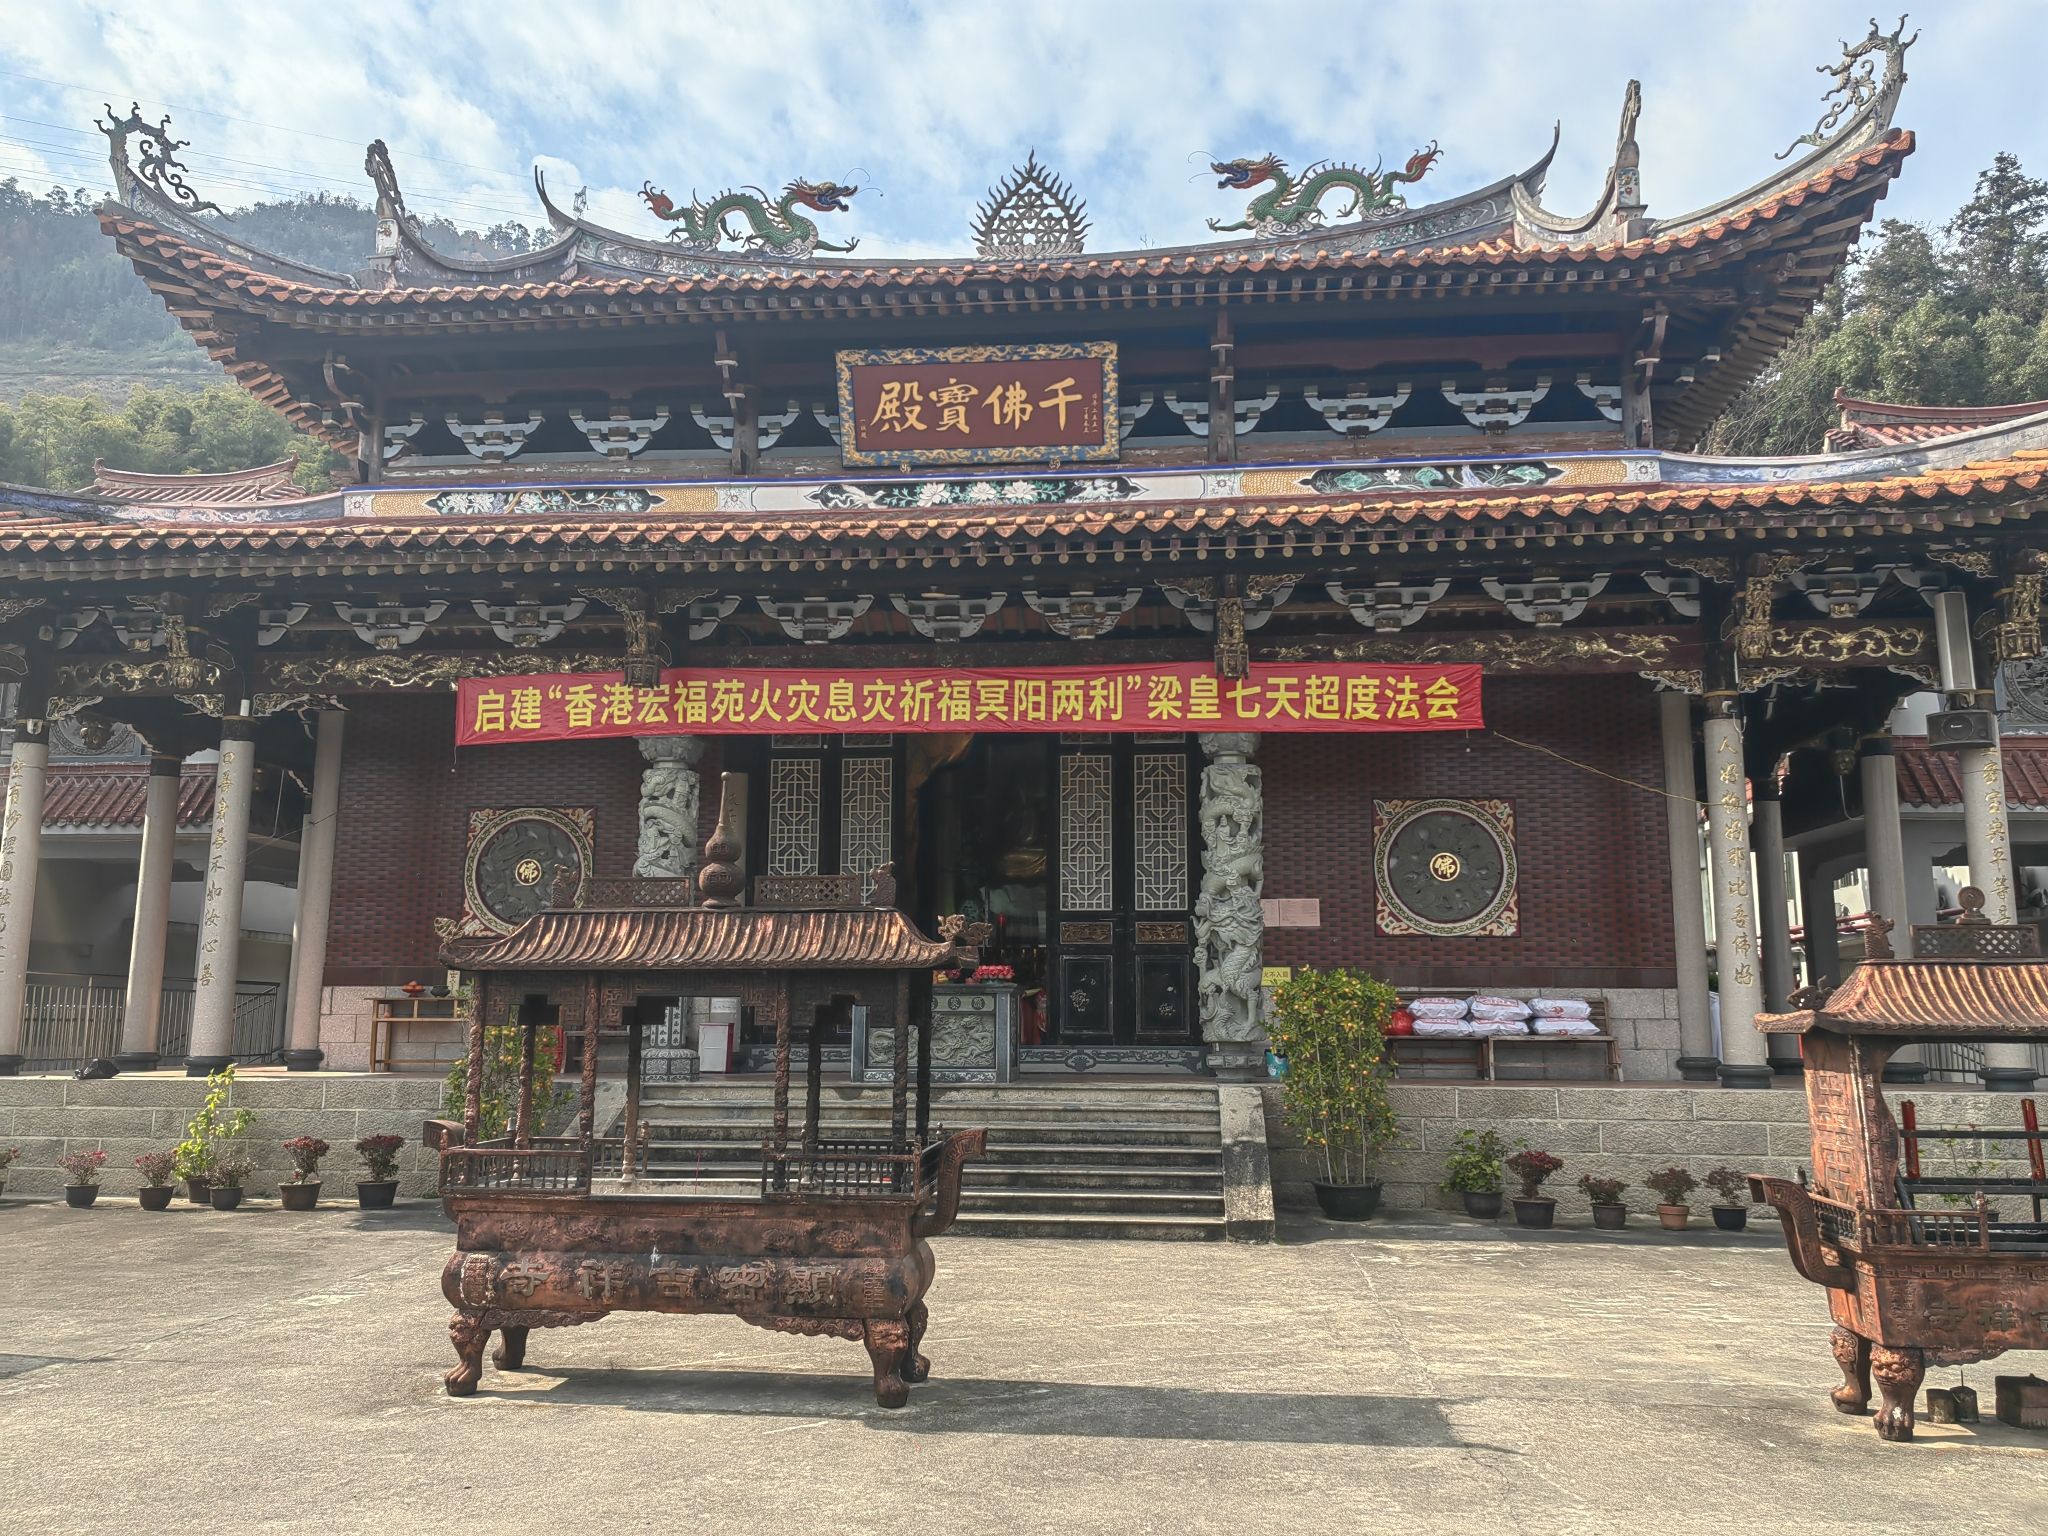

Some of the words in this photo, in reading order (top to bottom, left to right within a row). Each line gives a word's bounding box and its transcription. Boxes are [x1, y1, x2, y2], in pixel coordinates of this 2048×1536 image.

[869, 376, 1083, 434] 千佛寶殿
[518, 861, 539, 883] 佛
[1434, 855, 1456, 879] 佛
